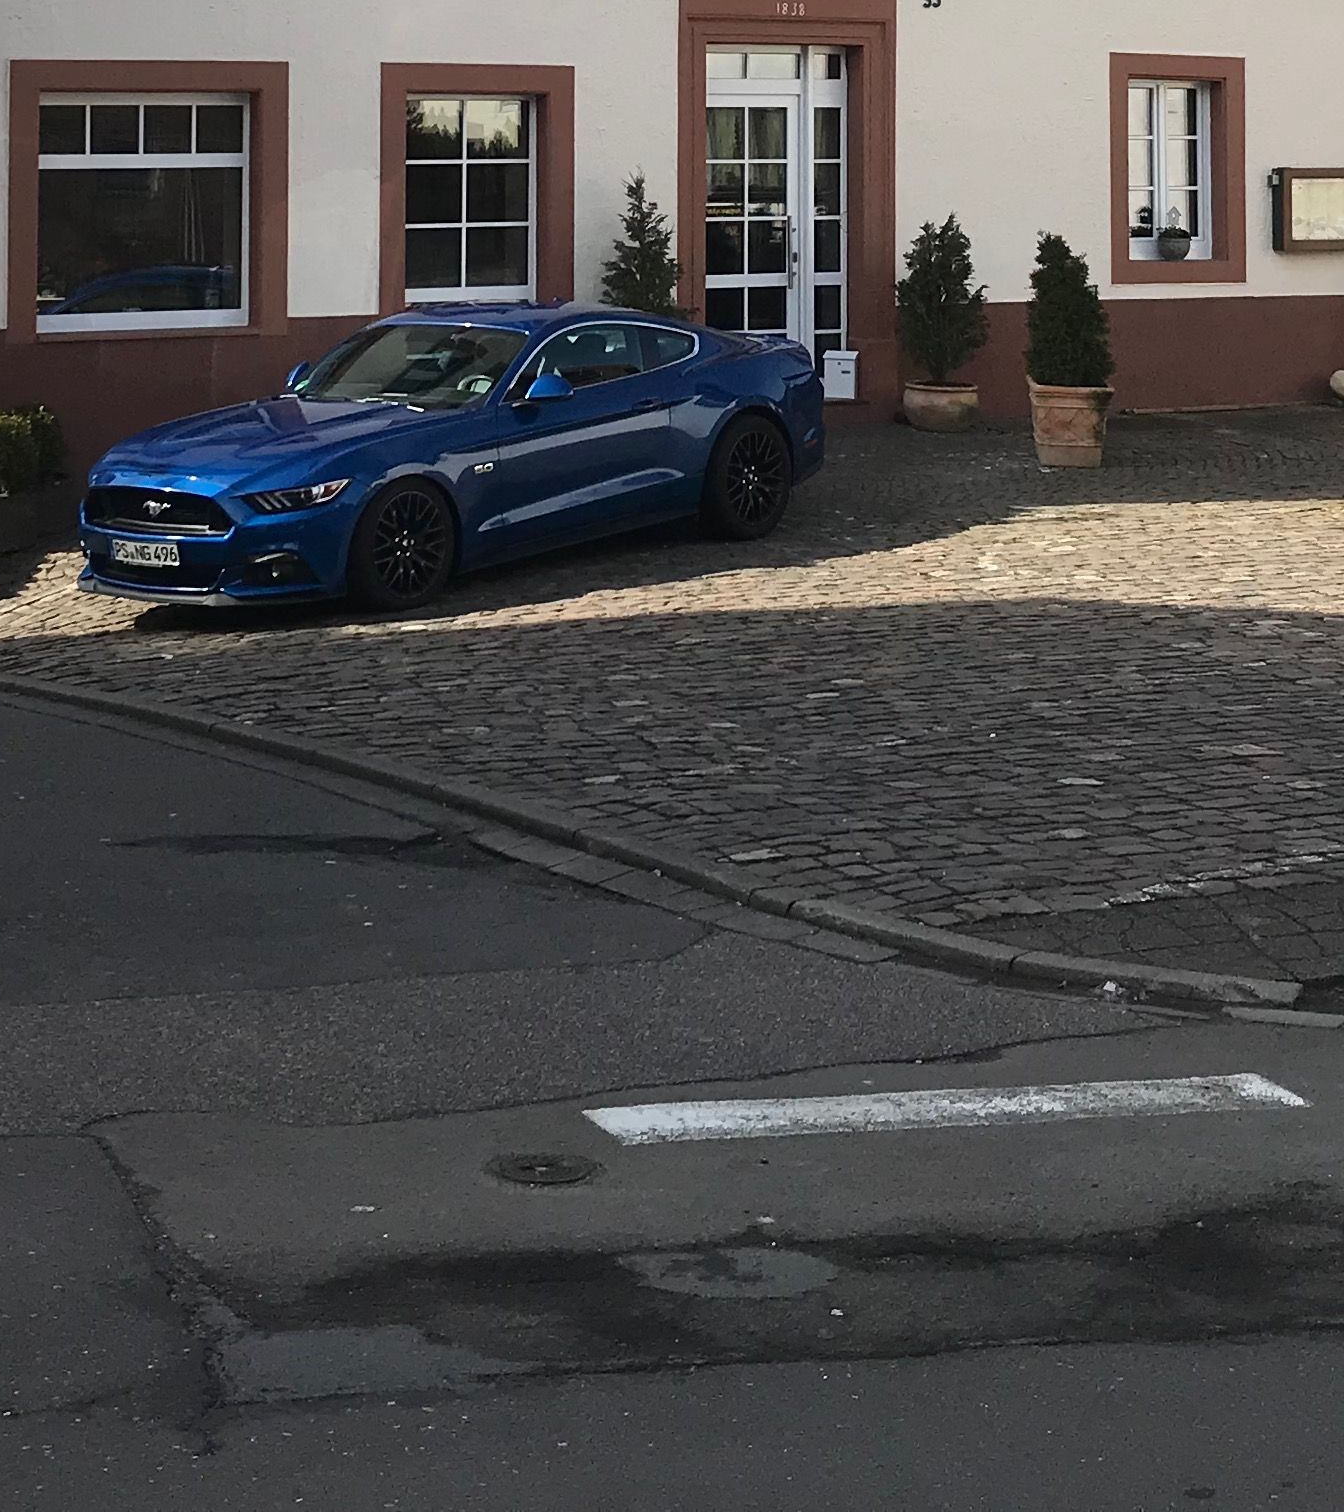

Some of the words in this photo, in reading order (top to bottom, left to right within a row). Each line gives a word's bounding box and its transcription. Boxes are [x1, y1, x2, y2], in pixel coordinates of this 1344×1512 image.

[776, 2, 806, 17] 1838
[115, 541, 129, 558] PS
[154, 546, 178, 562] 496
